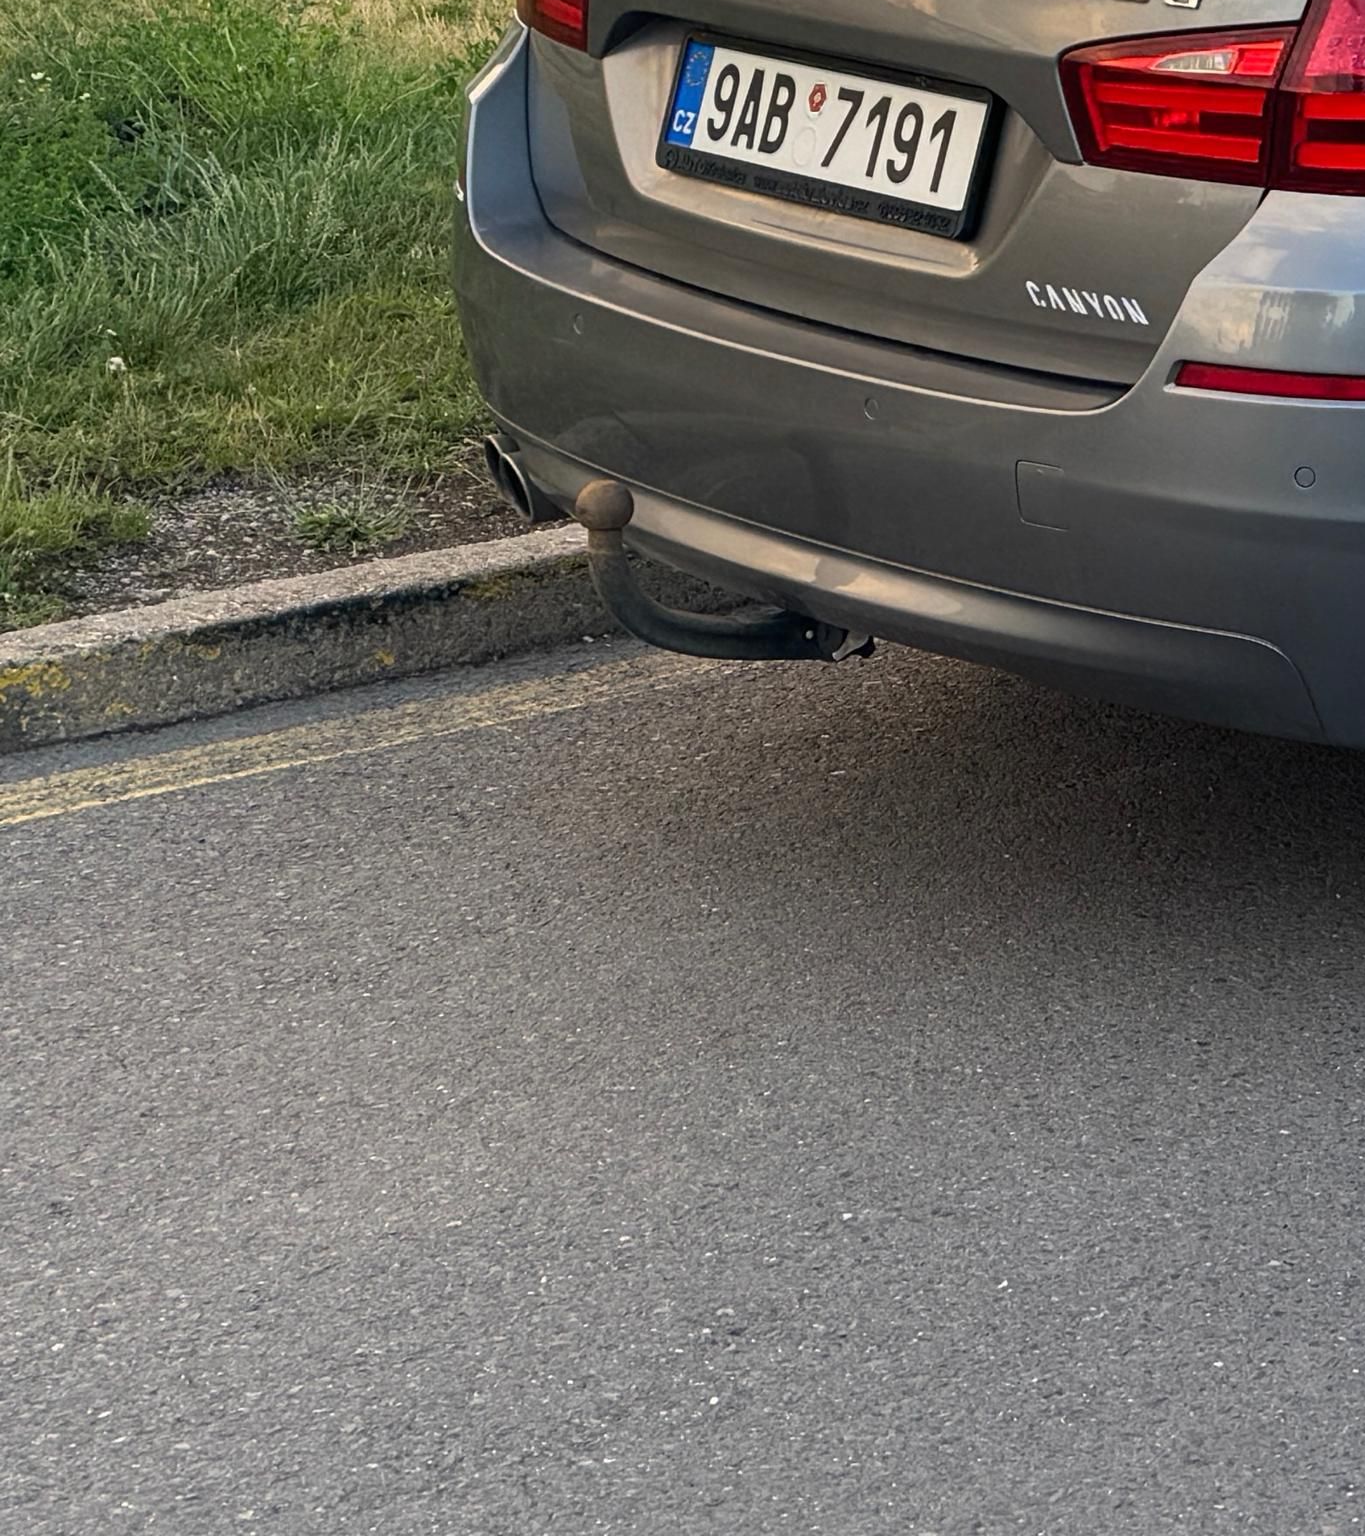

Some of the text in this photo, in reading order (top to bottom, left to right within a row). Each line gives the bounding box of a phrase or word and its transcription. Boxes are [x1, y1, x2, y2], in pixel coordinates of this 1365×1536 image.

[673, 109, 695, 134] CZ
[707, 64, 957, 193] 9AB 7191
[1025, 280, 1150, 325] CANYON
